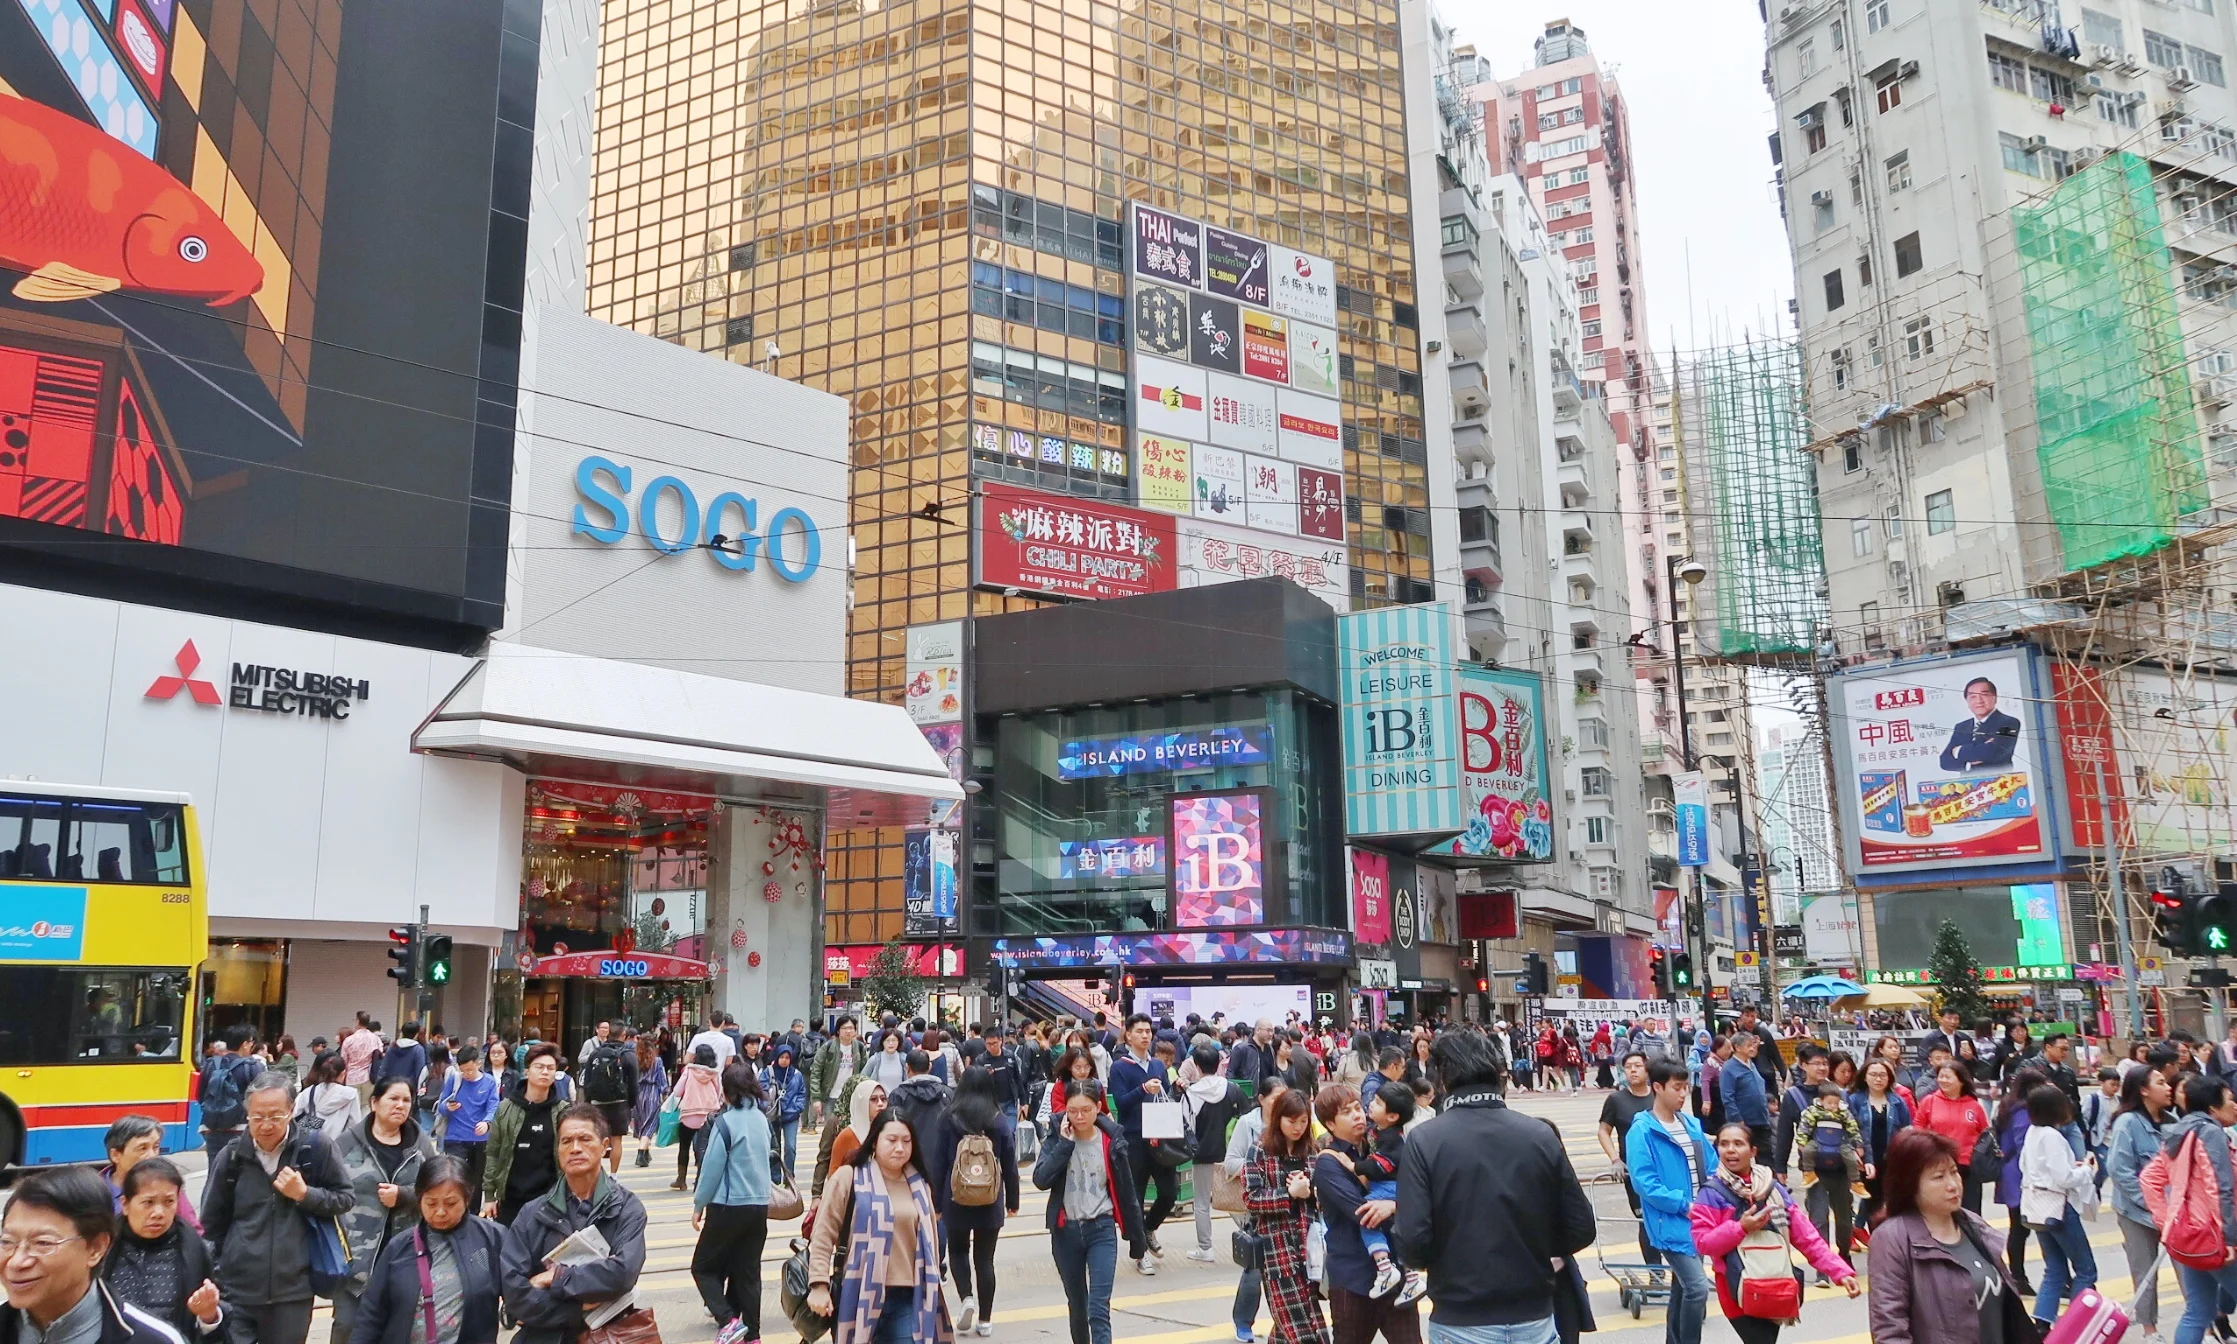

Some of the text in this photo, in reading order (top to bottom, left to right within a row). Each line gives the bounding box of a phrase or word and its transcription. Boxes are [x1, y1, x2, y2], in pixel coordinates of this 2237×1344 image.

[1139, 211, 1171, 245] THAI
[1146, 241, 1192, 280] 泰式食
[1245, 284, 1267, 301] 8/F
[1276, 301, 1288, 311] 8/F
[975, 425, 1122, 475] 傷心酸辣粉
[1143, 439, 1186, 463] 傷心
[1202, 451, 1237, 470] 新巴黎
[1142, 463, 1188, 484] 酸辣粉
[1229, 495, 1243, 506] 5/F
[573, 455, 821, 583] SOGO
[1026, 506, 1143, 556] 麻辣派對
[1026, 545, 1142, 582] CHILI PARTY
[1203, 539, 1327, 588] 花園餐廳
[1364, 646, 1425, 666] WELCOME
[231, 662, 369, 700] MITSUBISHI
[1360, 673, 1433, 695] LEISURE
[229, 685, 350, 720] ELECTRIC
[910, 703, 926, 716] 3/F
[1366, 709, 1416, 753] iB
[1417, 706, 1432, 749] 金百利
[1500, 698, 1524, 778] 金百利
[1859, 719, 1914, 748] 中風
[1083, 738, 1243, 766] ISLAND BEVERLEY
[1365, 750, 1434, 762] ISLAND BEVERLEY
[1371, 768, 1432, 787] DINING
[1477, 777, 1526, 792] BEVERLEY
[1078, 843, 1155, 872] 金百利
[1184, 832, 1253, 894] iB
[161, 893, 190, 904] 8288
[1400, 906, 1408, 915] THE
[1398, 916, 1411, 927] BODY
[1399, 927, 1411, 938] SHOP
[600, 960, 648, 976] SOGO
